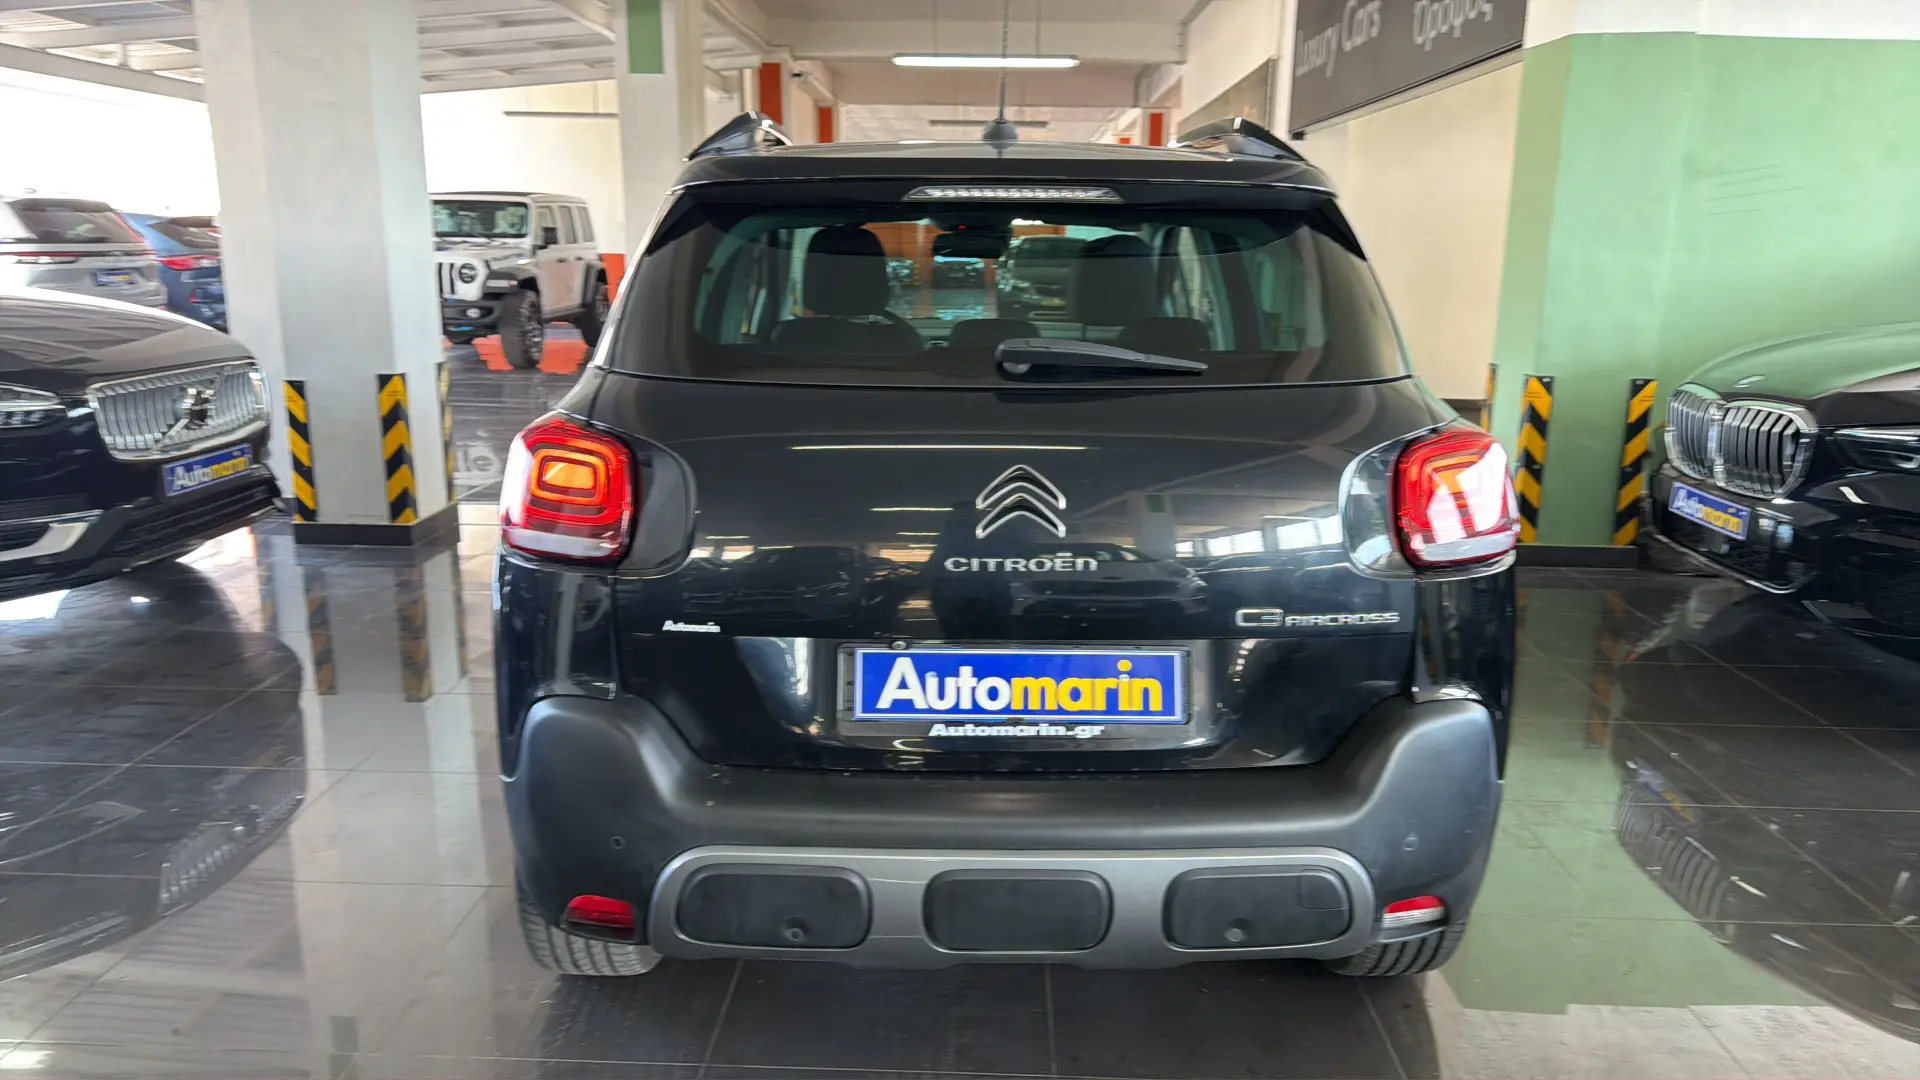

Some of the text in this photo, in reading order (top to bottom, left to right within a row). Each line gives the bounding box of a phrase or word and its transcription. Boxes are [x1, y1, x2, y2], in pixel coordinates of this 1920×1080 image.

[1341, 0, 1382, 52] Cars
[944, 552, 1098, 572] CITROËN
[1284, 612, 1400, 627] AIRCROSS
[875, 656, 1163, 712] Automarin
[928, 723, 1106, 739] Automarin.gr
